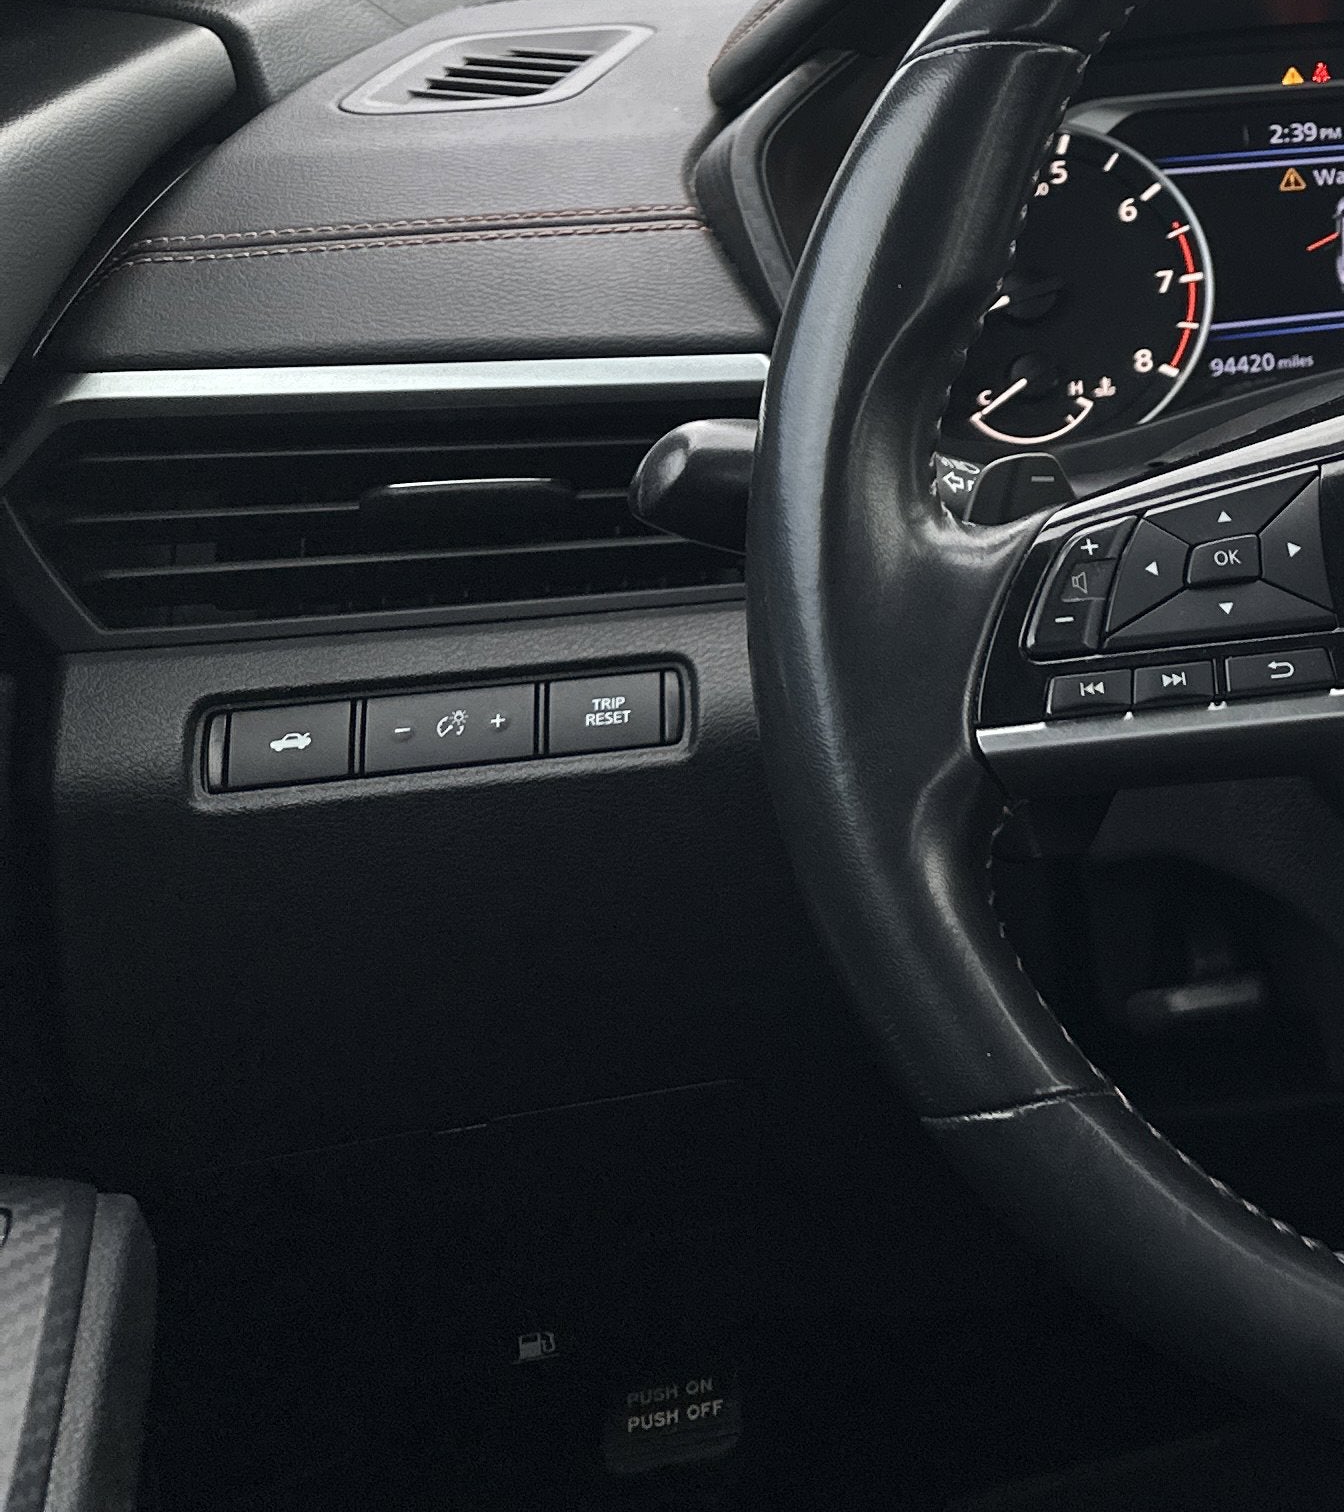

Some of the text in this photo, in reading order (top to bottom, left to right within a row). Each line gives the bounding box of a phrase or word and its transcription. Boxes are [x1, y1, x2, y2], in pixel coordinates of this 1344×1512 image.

[1050, 159, 1068, 185] 5
[1118, 198, 1138, 222] 6
[1155, 270, 1174, 294] 7
[1134, 348, 1153, 373] 8
[1209, 352, 1314, 378] 94420 miles
[976, 389, 992, 406] C
[1068, 380, 1083, 396] H
[1213, 549, 1243, 567] OK
[592, 695, 626, 712] TRIP
[585, 709, 631, 727] RESET
[627, 1377, 714, 1408] PUSH ON
[627, 1399, 724, 1433] PUSH OFF
